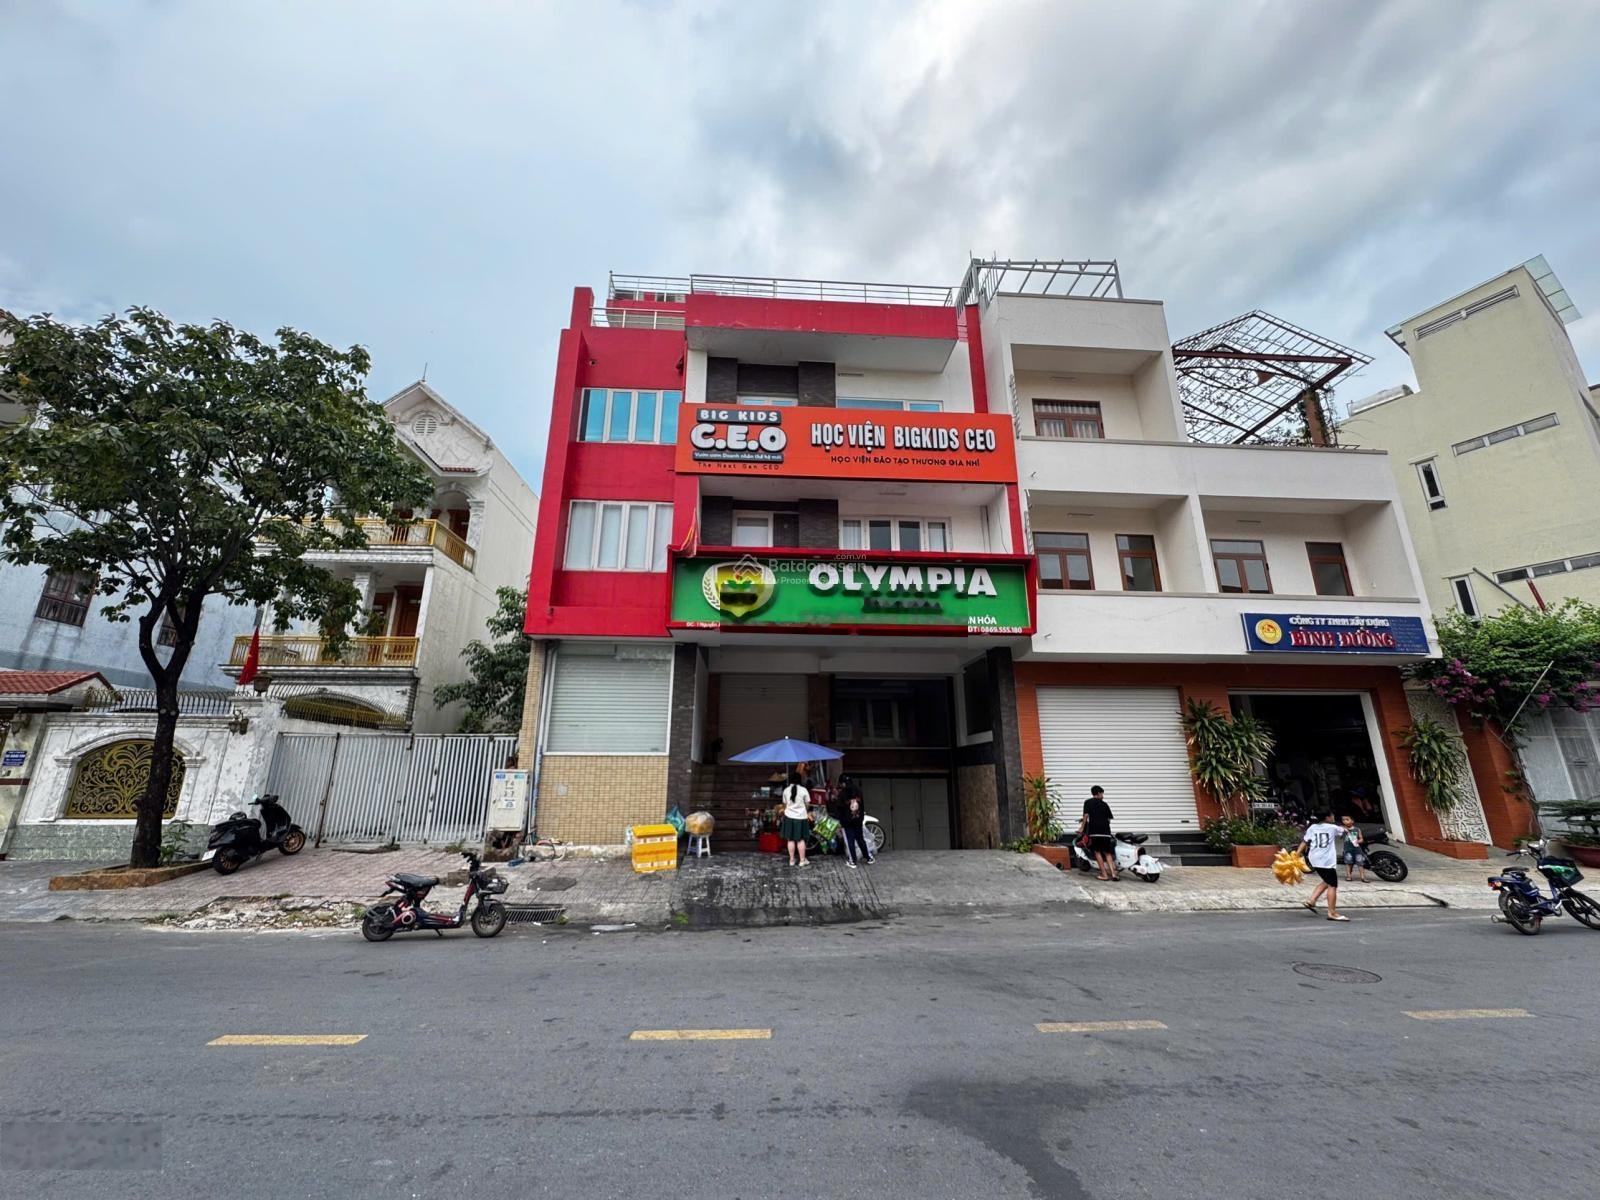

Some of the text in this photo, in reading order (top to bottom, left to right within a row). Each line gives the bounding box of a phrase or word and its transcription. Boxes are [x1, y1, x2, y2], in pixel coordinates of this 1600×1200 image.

[700, 409, 778, 422] BIG KIDS
[690, 422, 787, 452] C.E.O
[811, 420, 996, 452] HỌC VIỆN BIGKIDS CEO
[831, 456, 850, 464] HỌC
[854, 454, 871, 464] VIỆN
[893, 456, 910, 466] TẠO
[949, 458, 964, 466] GIA
[809, 564, 997, 596] OLYMPIA
[1288, 615, 1314, 625] CÔNG
[1315, 618, 1326, 626] TY
[1314, 832, 1329, 848] 10
